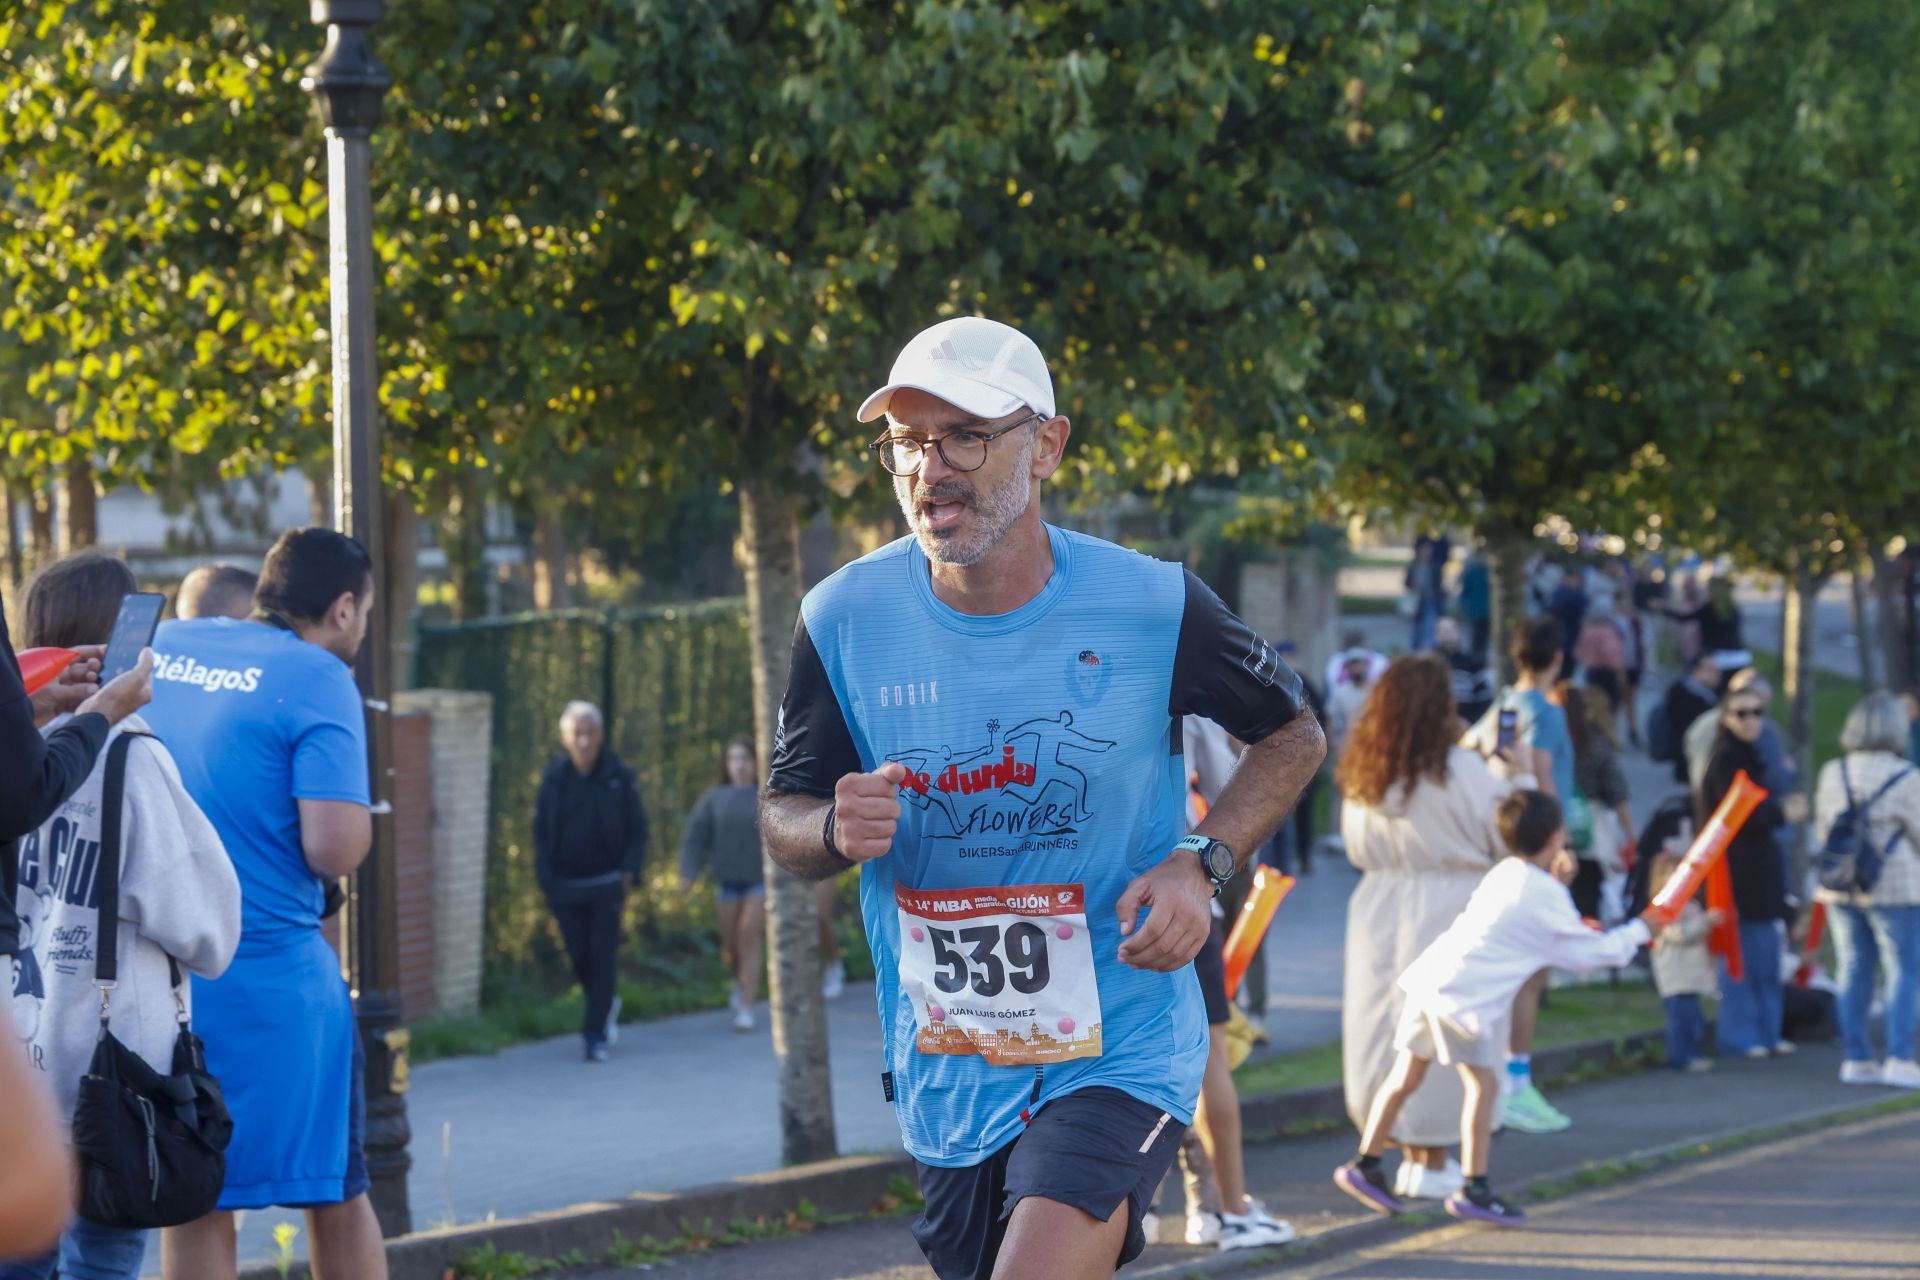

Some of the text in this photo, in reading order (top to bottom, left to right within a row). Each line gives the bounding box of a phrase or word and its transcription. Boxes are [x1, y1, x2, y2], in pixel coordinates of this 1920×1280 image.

[880, 680, 938, 707] GOBIK
[968, 803, 1072, 834] FLOWERS
[933, 898, 973, 913] MBA
[974, 895, 997, 904] media
[1006, 894, 1049, 909] GIJÓN
[926, 921, 1050, 997] 539
[948, 1008, 1036, 1019] JUAN LUIS GÓMEZ
